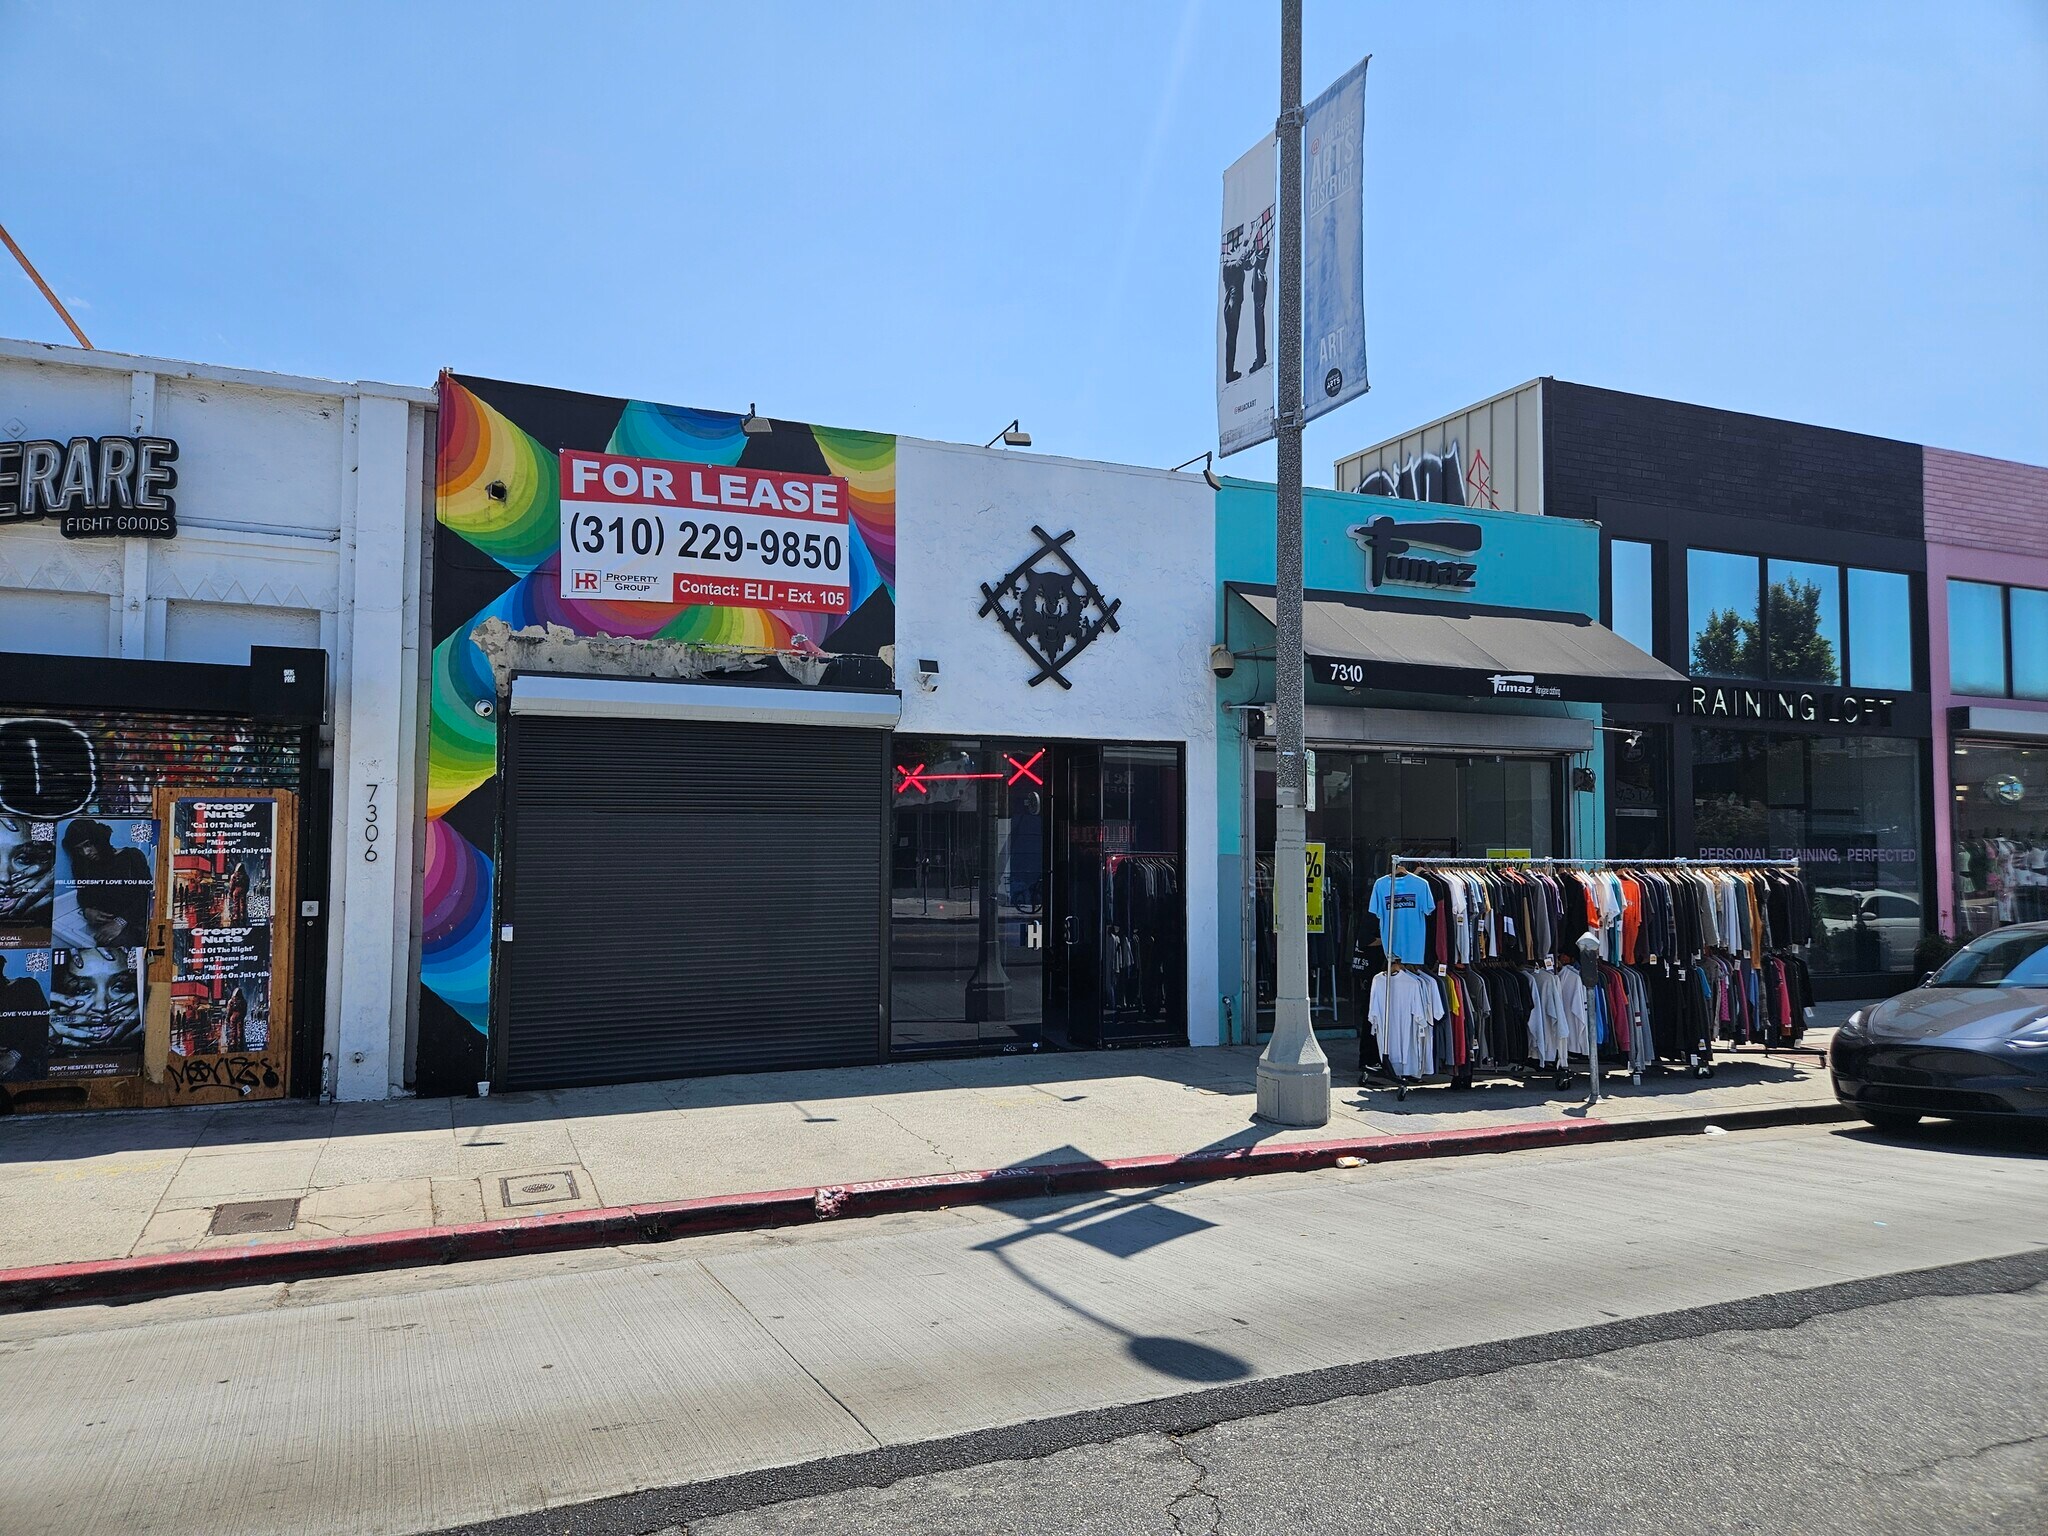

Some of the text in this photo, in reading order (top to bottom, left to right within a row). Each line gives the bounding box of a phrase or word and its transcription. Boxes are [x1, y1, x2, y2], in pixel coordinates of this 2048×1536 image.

[1311, 129, 1354, 190] ARTS
[1310, 163, 1353, 211] DISTRICT
[1319, 327, 1344, 365] ART
[572, 459, 838, 516] FOR LEASE
[66, 516, 169, 531] FIGHT GOODS
[570, 512, 842, 571] (310) 229-9850
[575, 572, 598, 590] HR
[606, 573, 658, 582] PROPERTY
[615, 583, 650, 592] GROUP
[679, 580, 739, 597] Contact:
[744, 583, 773, 601] ELI
[788, 589, 815, 604] Ext.
[821, 591, 844, 606] 105
[1330, 664, 1363, 682] 7310
[1677, 687, 1815, 722] RAINING
[193, 802, 254, 812] Creepy
[364, 784, 378, 862] 7306
[1700, 848, 1766, 860] PERSONAL
[1847, 848, 1916, 862] PERFECTED
[191, 928, 252, 936] Creepy
[201, 936, 244, 944] Nuts
[1028, 924, 1042, 948] H
[853, 1176, 938, 1192] STOPPING
[948, 1172, 982, 1182] BUS
[987, 1168, 1034, 1178] ZONE
